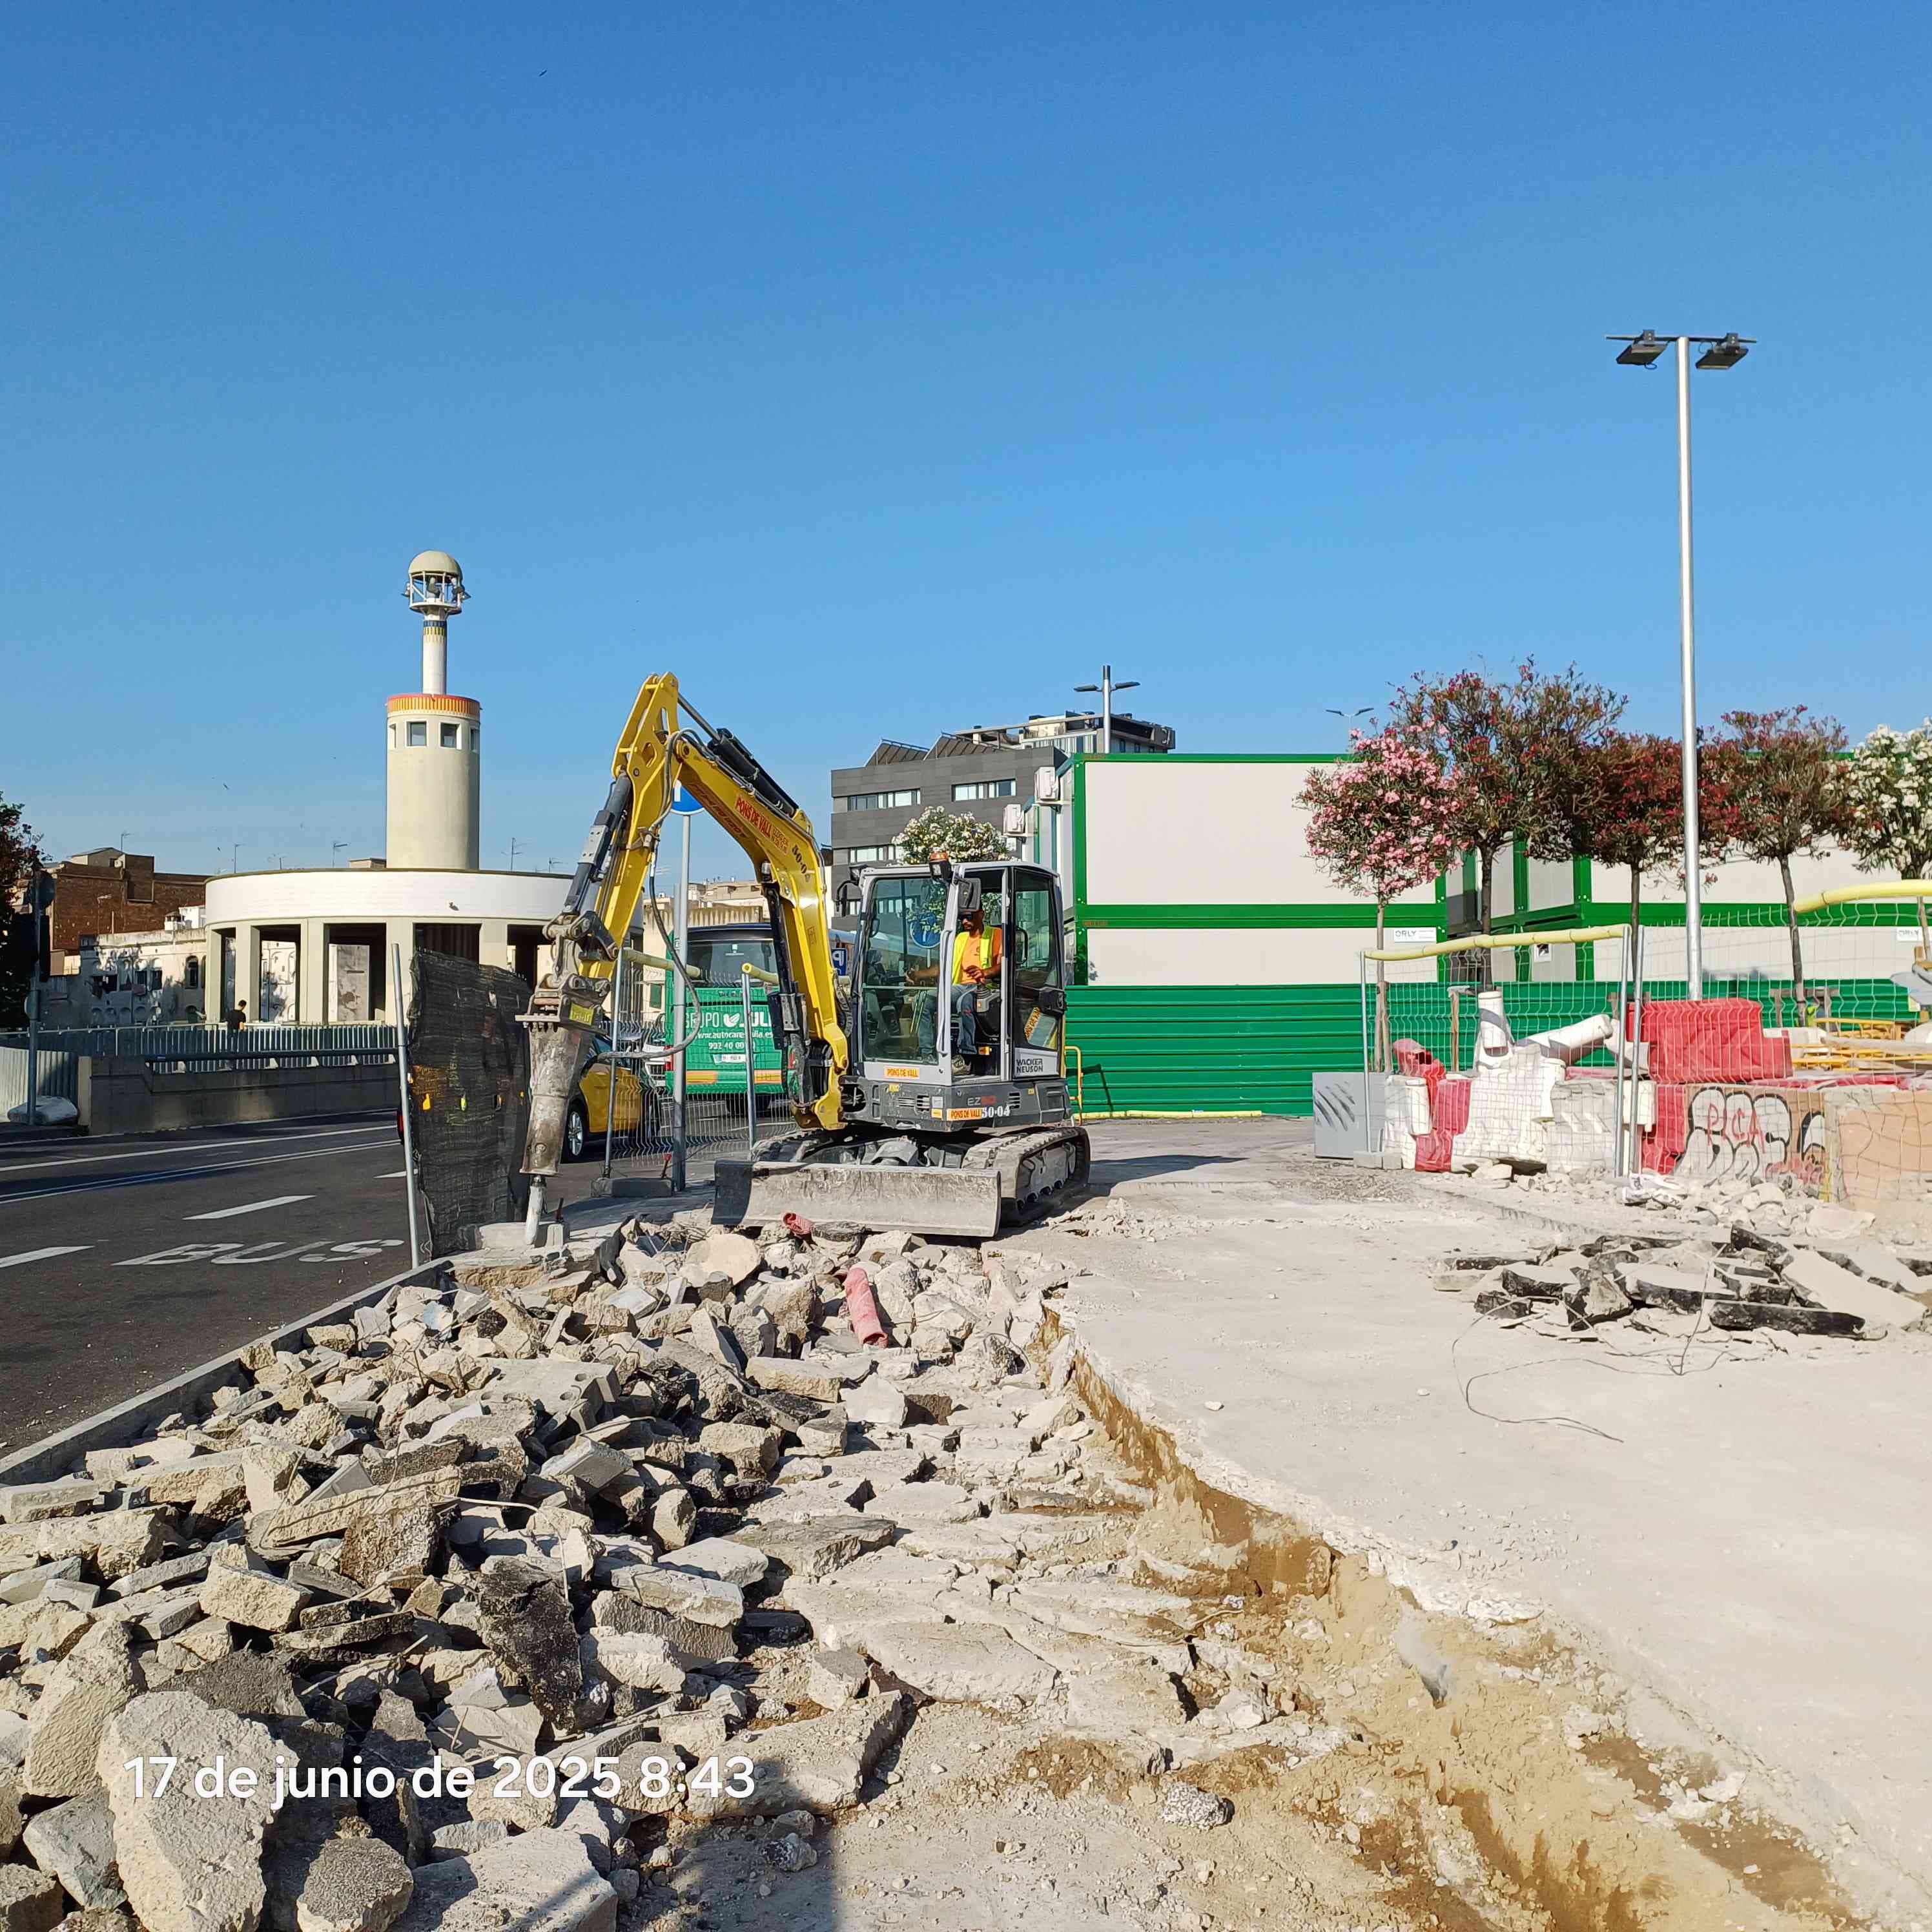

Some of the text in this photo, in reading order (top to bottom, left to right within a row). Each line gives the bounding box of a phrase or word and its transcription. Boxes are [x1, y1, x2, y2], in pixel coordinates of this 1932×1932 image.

[887, 1068, 899, 1076] PONS
[951, 1109, 963, 1119] PONS
[110, 1239, 404, 1266] BUS
